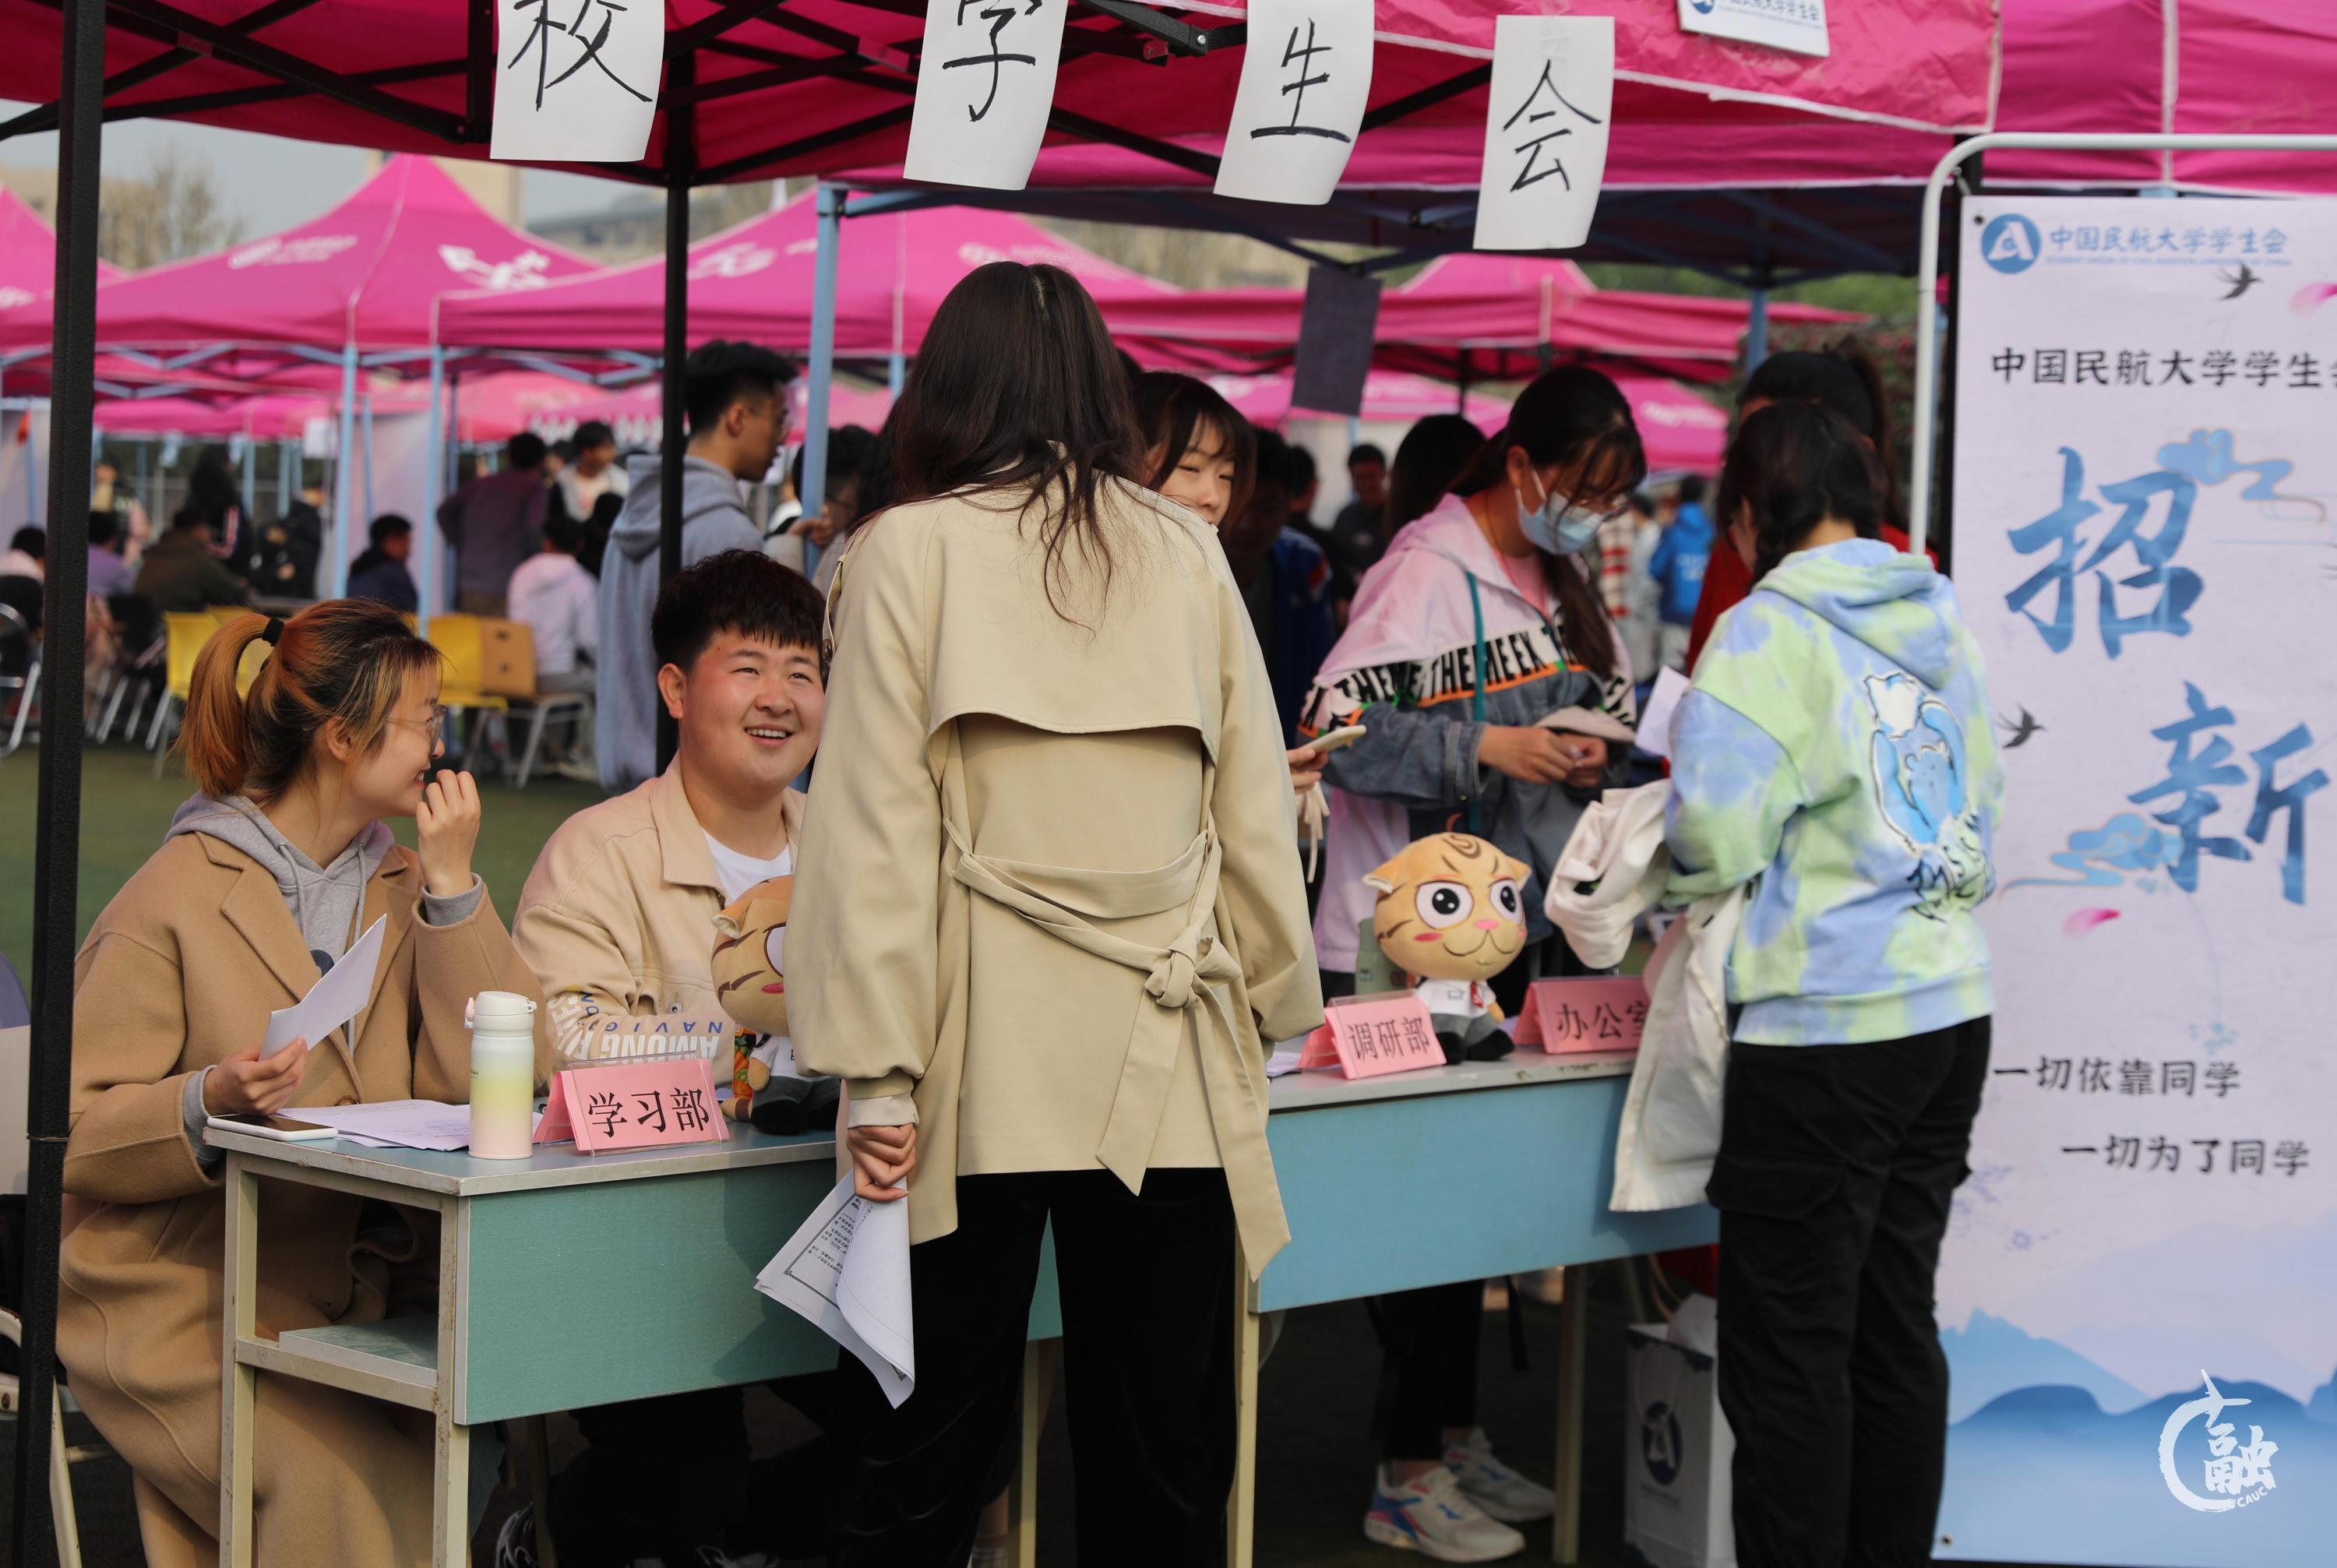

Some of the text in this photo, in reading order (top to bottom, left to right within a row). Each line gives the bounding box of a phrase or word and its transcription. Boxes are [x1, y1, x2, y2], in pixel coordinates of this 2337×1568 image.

[508, 0, 653, 111] 校
[1250, 18, 1352, 143] 生
[1503, 59, 1602, 192] 会
[2049, 225, 2289, 254] 中国民航大学学生会
[1992, 347, 2337, 388] 中国民航大学学生
[2004, 446, 2205, 661] 招
[2127, 680, 2329, 905] 新
[1348, 1016, 1431, 1062] 调研部
[1993, 1055, 2242, 1098] 一切依靠同学
[587, 1087, 710, 1139] 学习部
[2062, 1133, 2310, 1176] 一切为了同学
